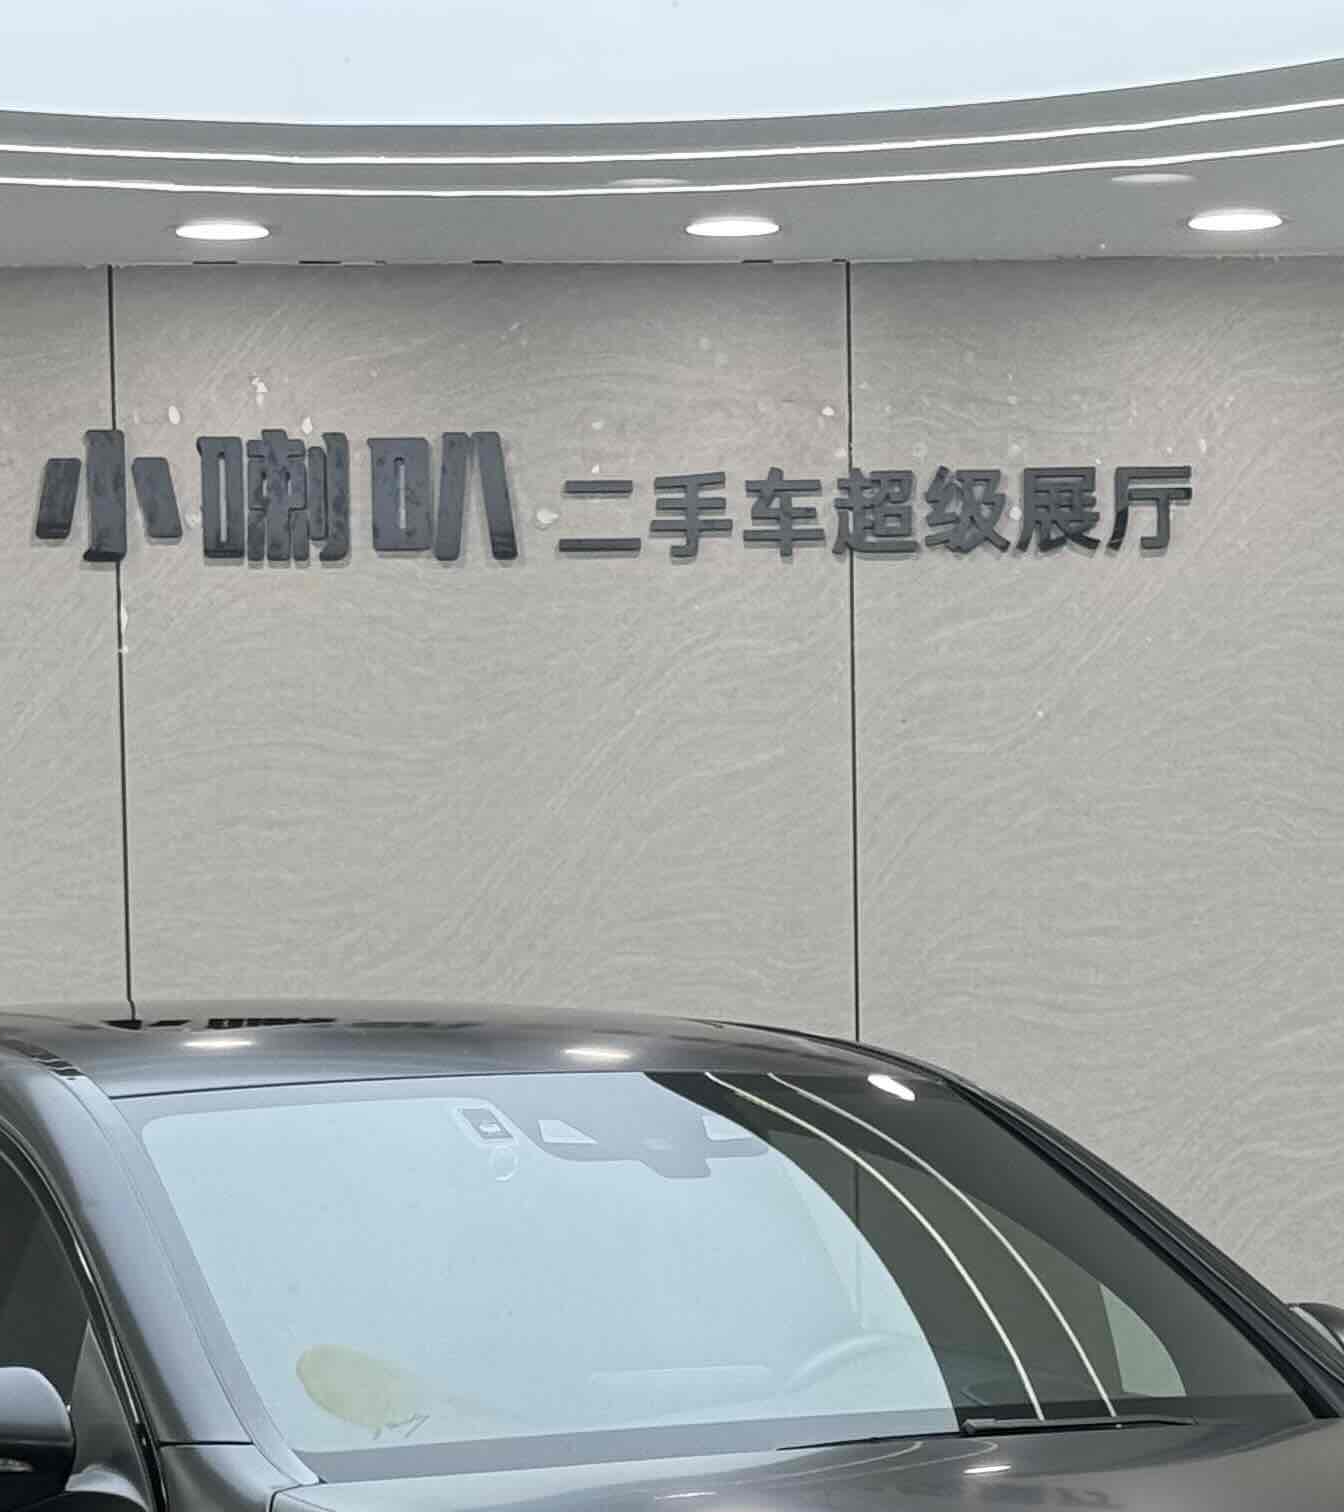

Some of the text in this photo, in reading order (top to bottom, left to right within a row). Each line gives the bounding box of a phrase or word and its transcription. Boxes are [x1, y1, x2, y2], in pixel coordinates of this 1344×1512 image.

[35, 429, 1194, 563] 小喇叭 二手车超级展厅
